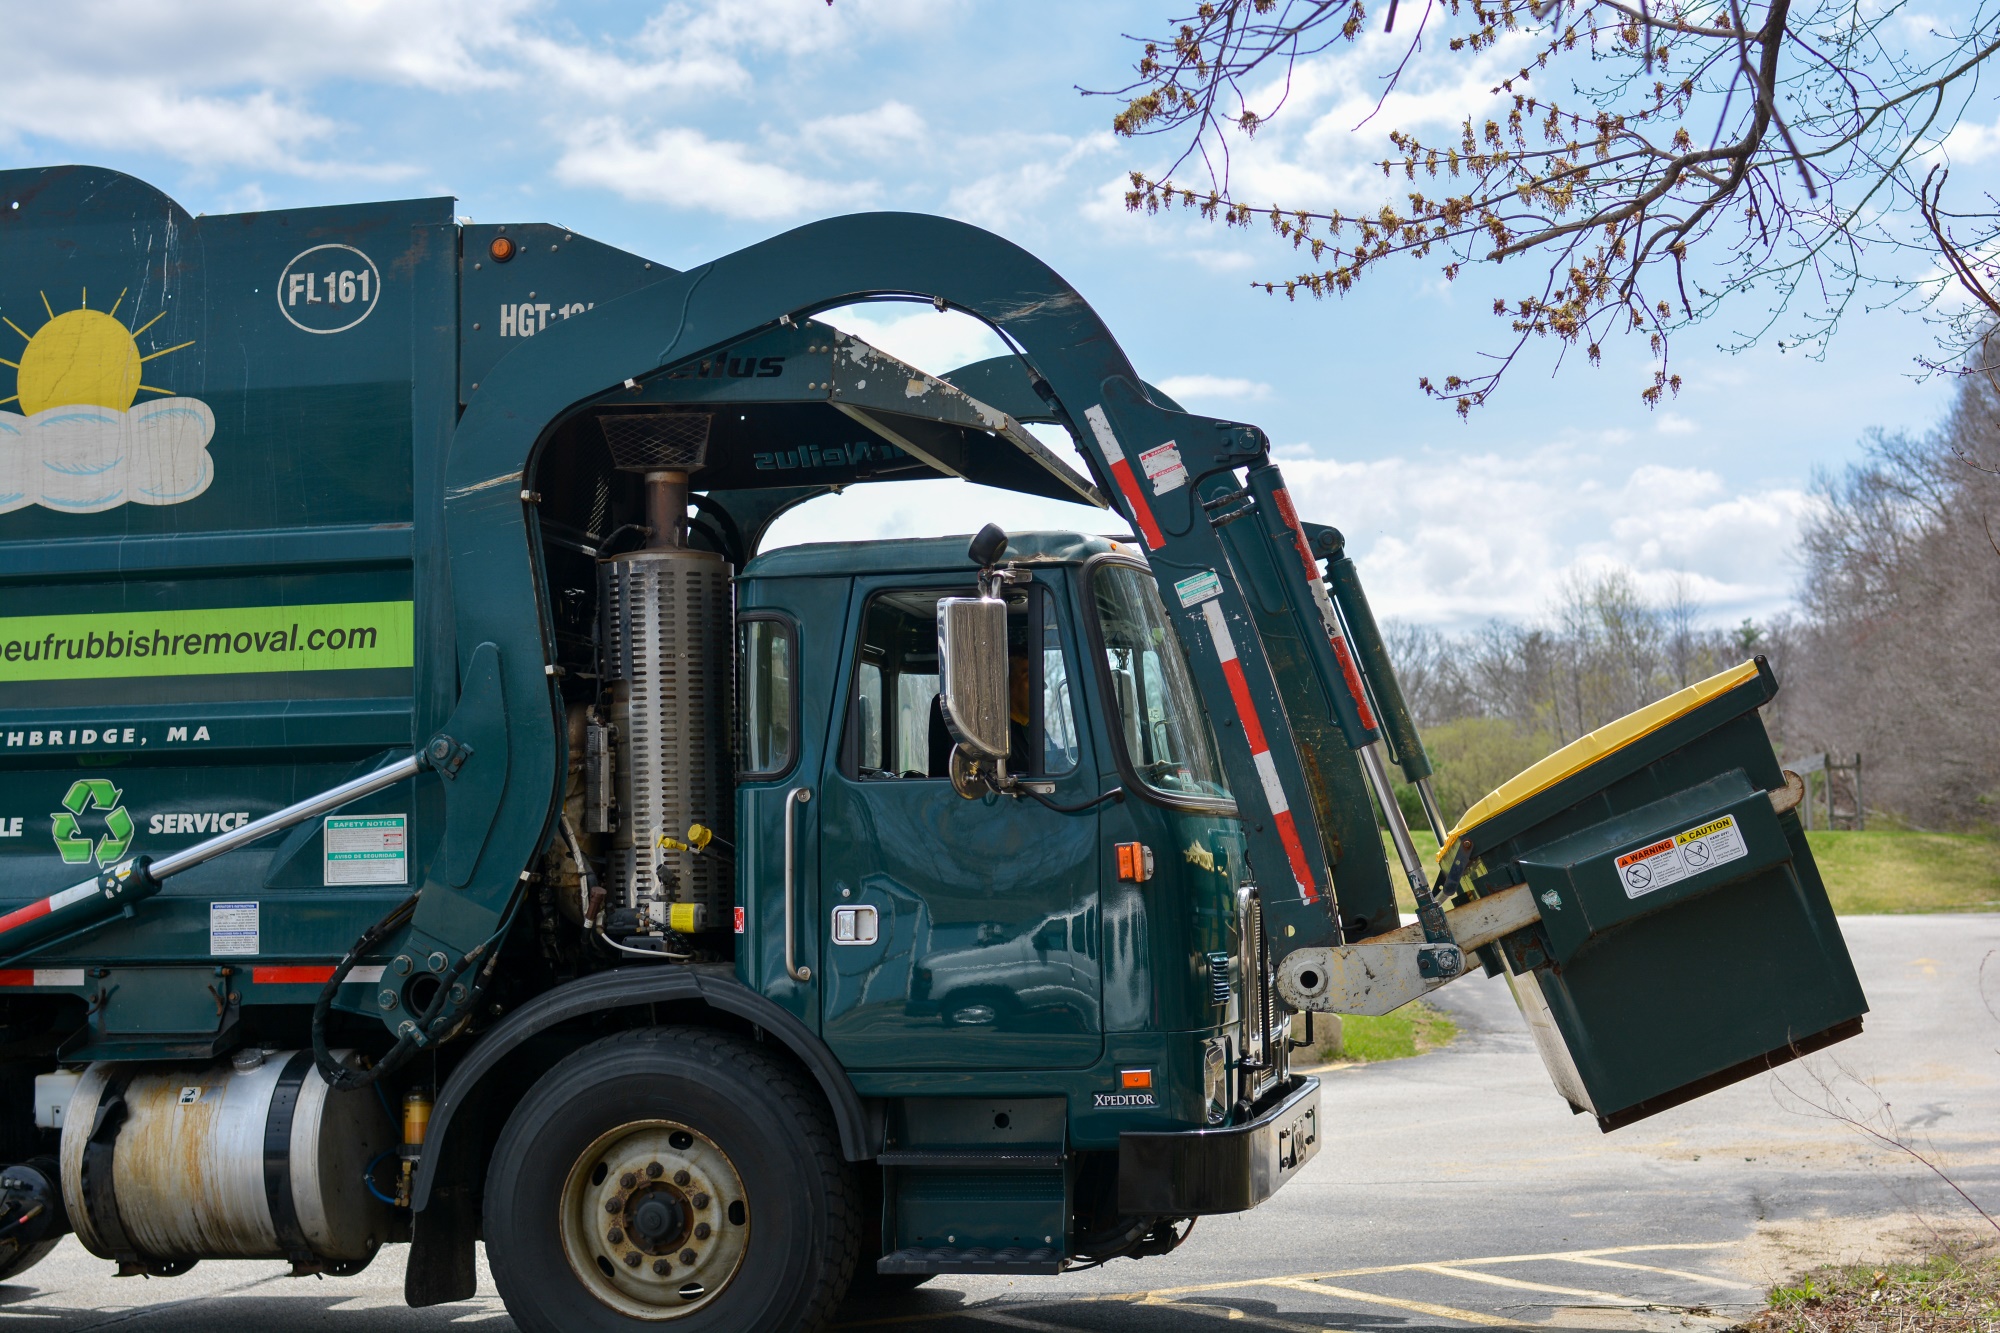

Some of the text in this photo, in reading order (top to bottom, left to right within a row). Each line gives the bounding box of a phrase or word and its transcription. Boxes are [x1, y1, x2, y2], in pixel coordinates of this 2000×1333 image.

[0, 623, 378, 662] eufrubbishremoval.com
[166, 726, 211, 742] MA
[149, 812, 249, 834] SERVICE
[1688, 819, 1730, 839] CAUTION
[1630, 842, 1671, 862] WARNING
[1094, 1094, 1156, 1107] XPEDITOR
